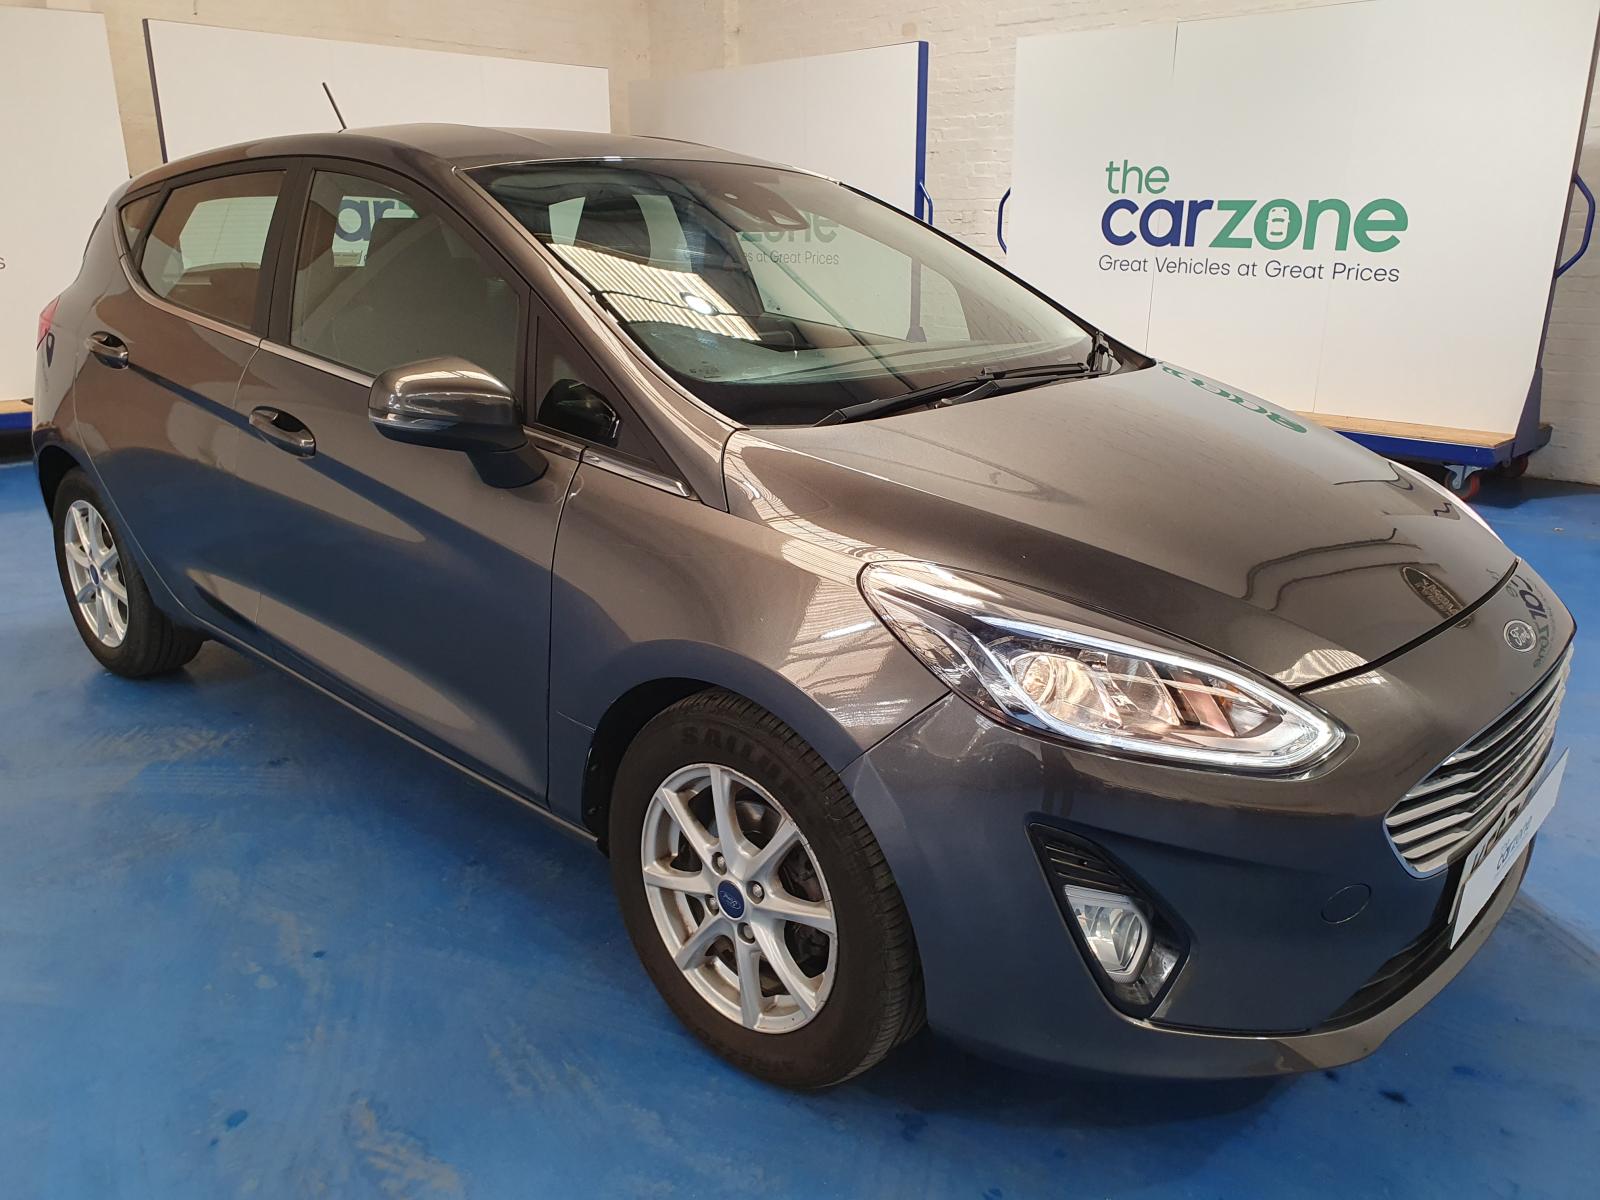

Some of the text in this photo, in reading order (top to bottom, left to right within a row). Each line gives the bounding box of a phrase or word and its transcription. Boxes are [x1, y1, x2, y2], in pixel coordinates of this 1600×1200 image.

[1105, 159, 1170, 194] the
[1101, 198, 1409, 253] carzone
[756, 251, 768, 264] at
[770, 251, 801, 264] Great
[804, 251, 840, 265] Prices
[1098, 254, 1400, 282] Great Vehicles at Great Prices
